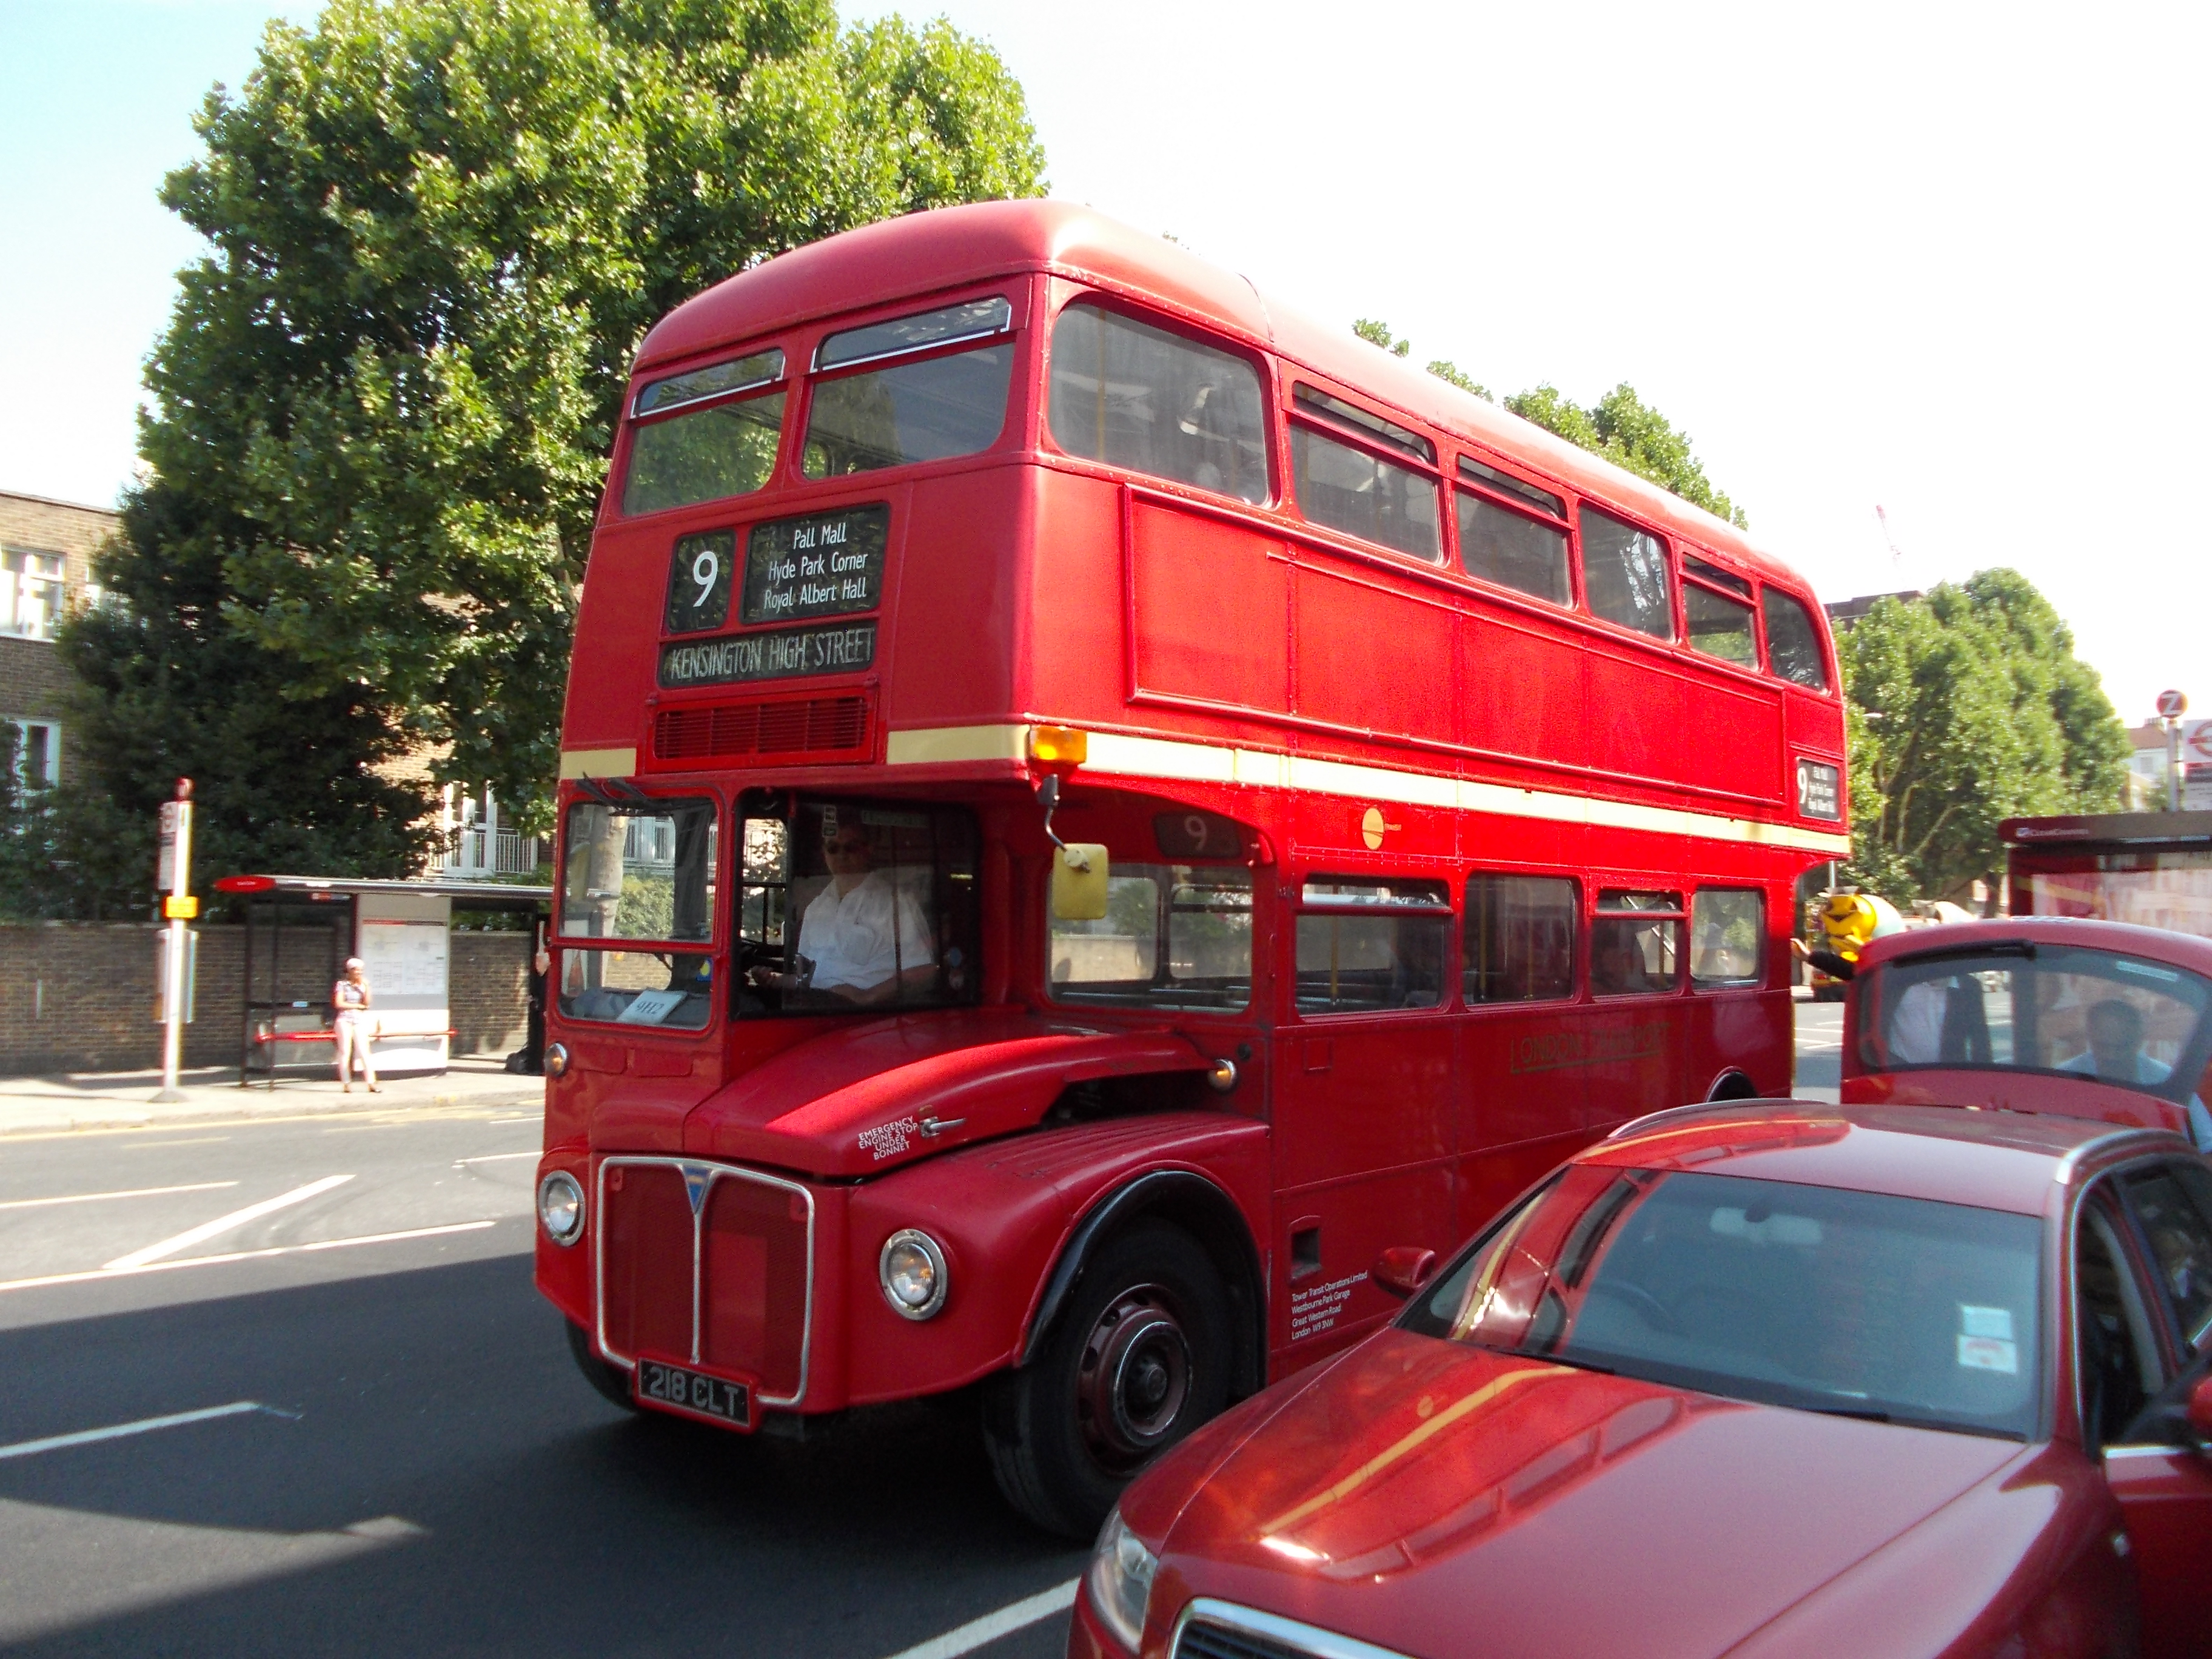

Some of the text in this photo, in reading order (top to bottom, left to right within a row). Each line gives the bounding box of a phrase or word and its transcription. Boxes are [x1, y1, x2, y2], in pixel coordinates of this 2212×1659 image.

[793, 522, 847, 550] Pall Mall
[693, 551, 719, 607] 9
[768, 552, 868, 586] Hyde Park Corner
[764, 577, 867, 614] Royal Albert Hall
[671, 628, 876, 680] KENSINGTON HIGH STREET
[2162, 693, 2183, 715] Z
[1797, 767, 1807, 804] 9
[1184, 816, 1207, 850] 9
[1510, 1033, 1583, 1074] LONDON
[859, 1116, 913, 1141] EMERGENCY
[859, 1122, 918, 1149] ENGINE STOP
[875, 1135, 906, 1151] UNDER
[874, 1141, 910, 1160] BONNET
[1292, 1269, 1368, 1302] Tower Transit Operations Limited
[1292, 1290, 1350, 1314] Westbourne Park Garage
[1292, 1302, 1342, 1327] Great Western Road
[1292, 1326, 1311, 1340] London
[1312, 1322, 1322, 1332] W9
[649, 1366, 739, 1417] 218 CLT
